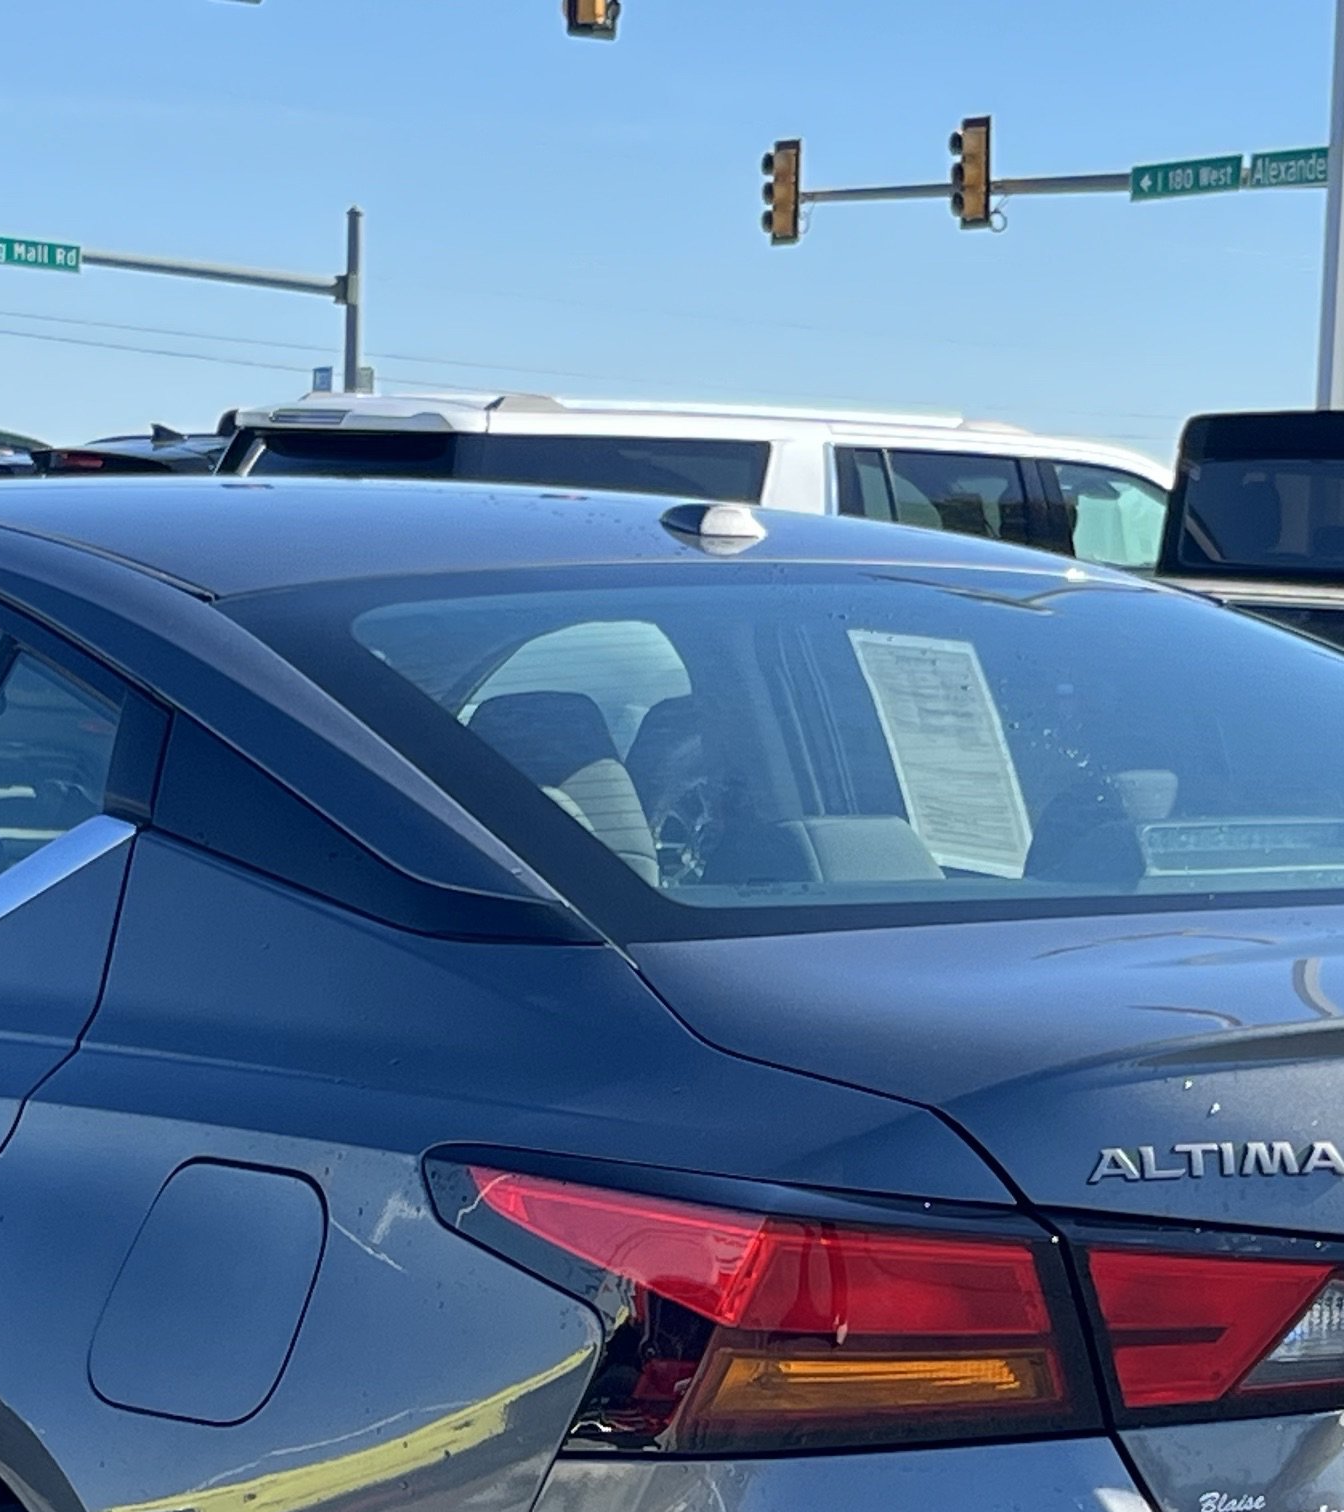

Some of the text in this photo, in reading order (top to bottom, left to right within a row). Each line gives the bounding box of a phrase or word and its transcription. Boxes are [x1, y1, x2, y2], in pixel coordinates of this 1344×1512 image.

[1168, 168, 1194, 190] 180
[1199, 165, 1233, 187] West
[1251, 152, 1327, 185] Alexande
[14, 242, 49, 265] Mall
[55, 248, 77, 267] Rd
